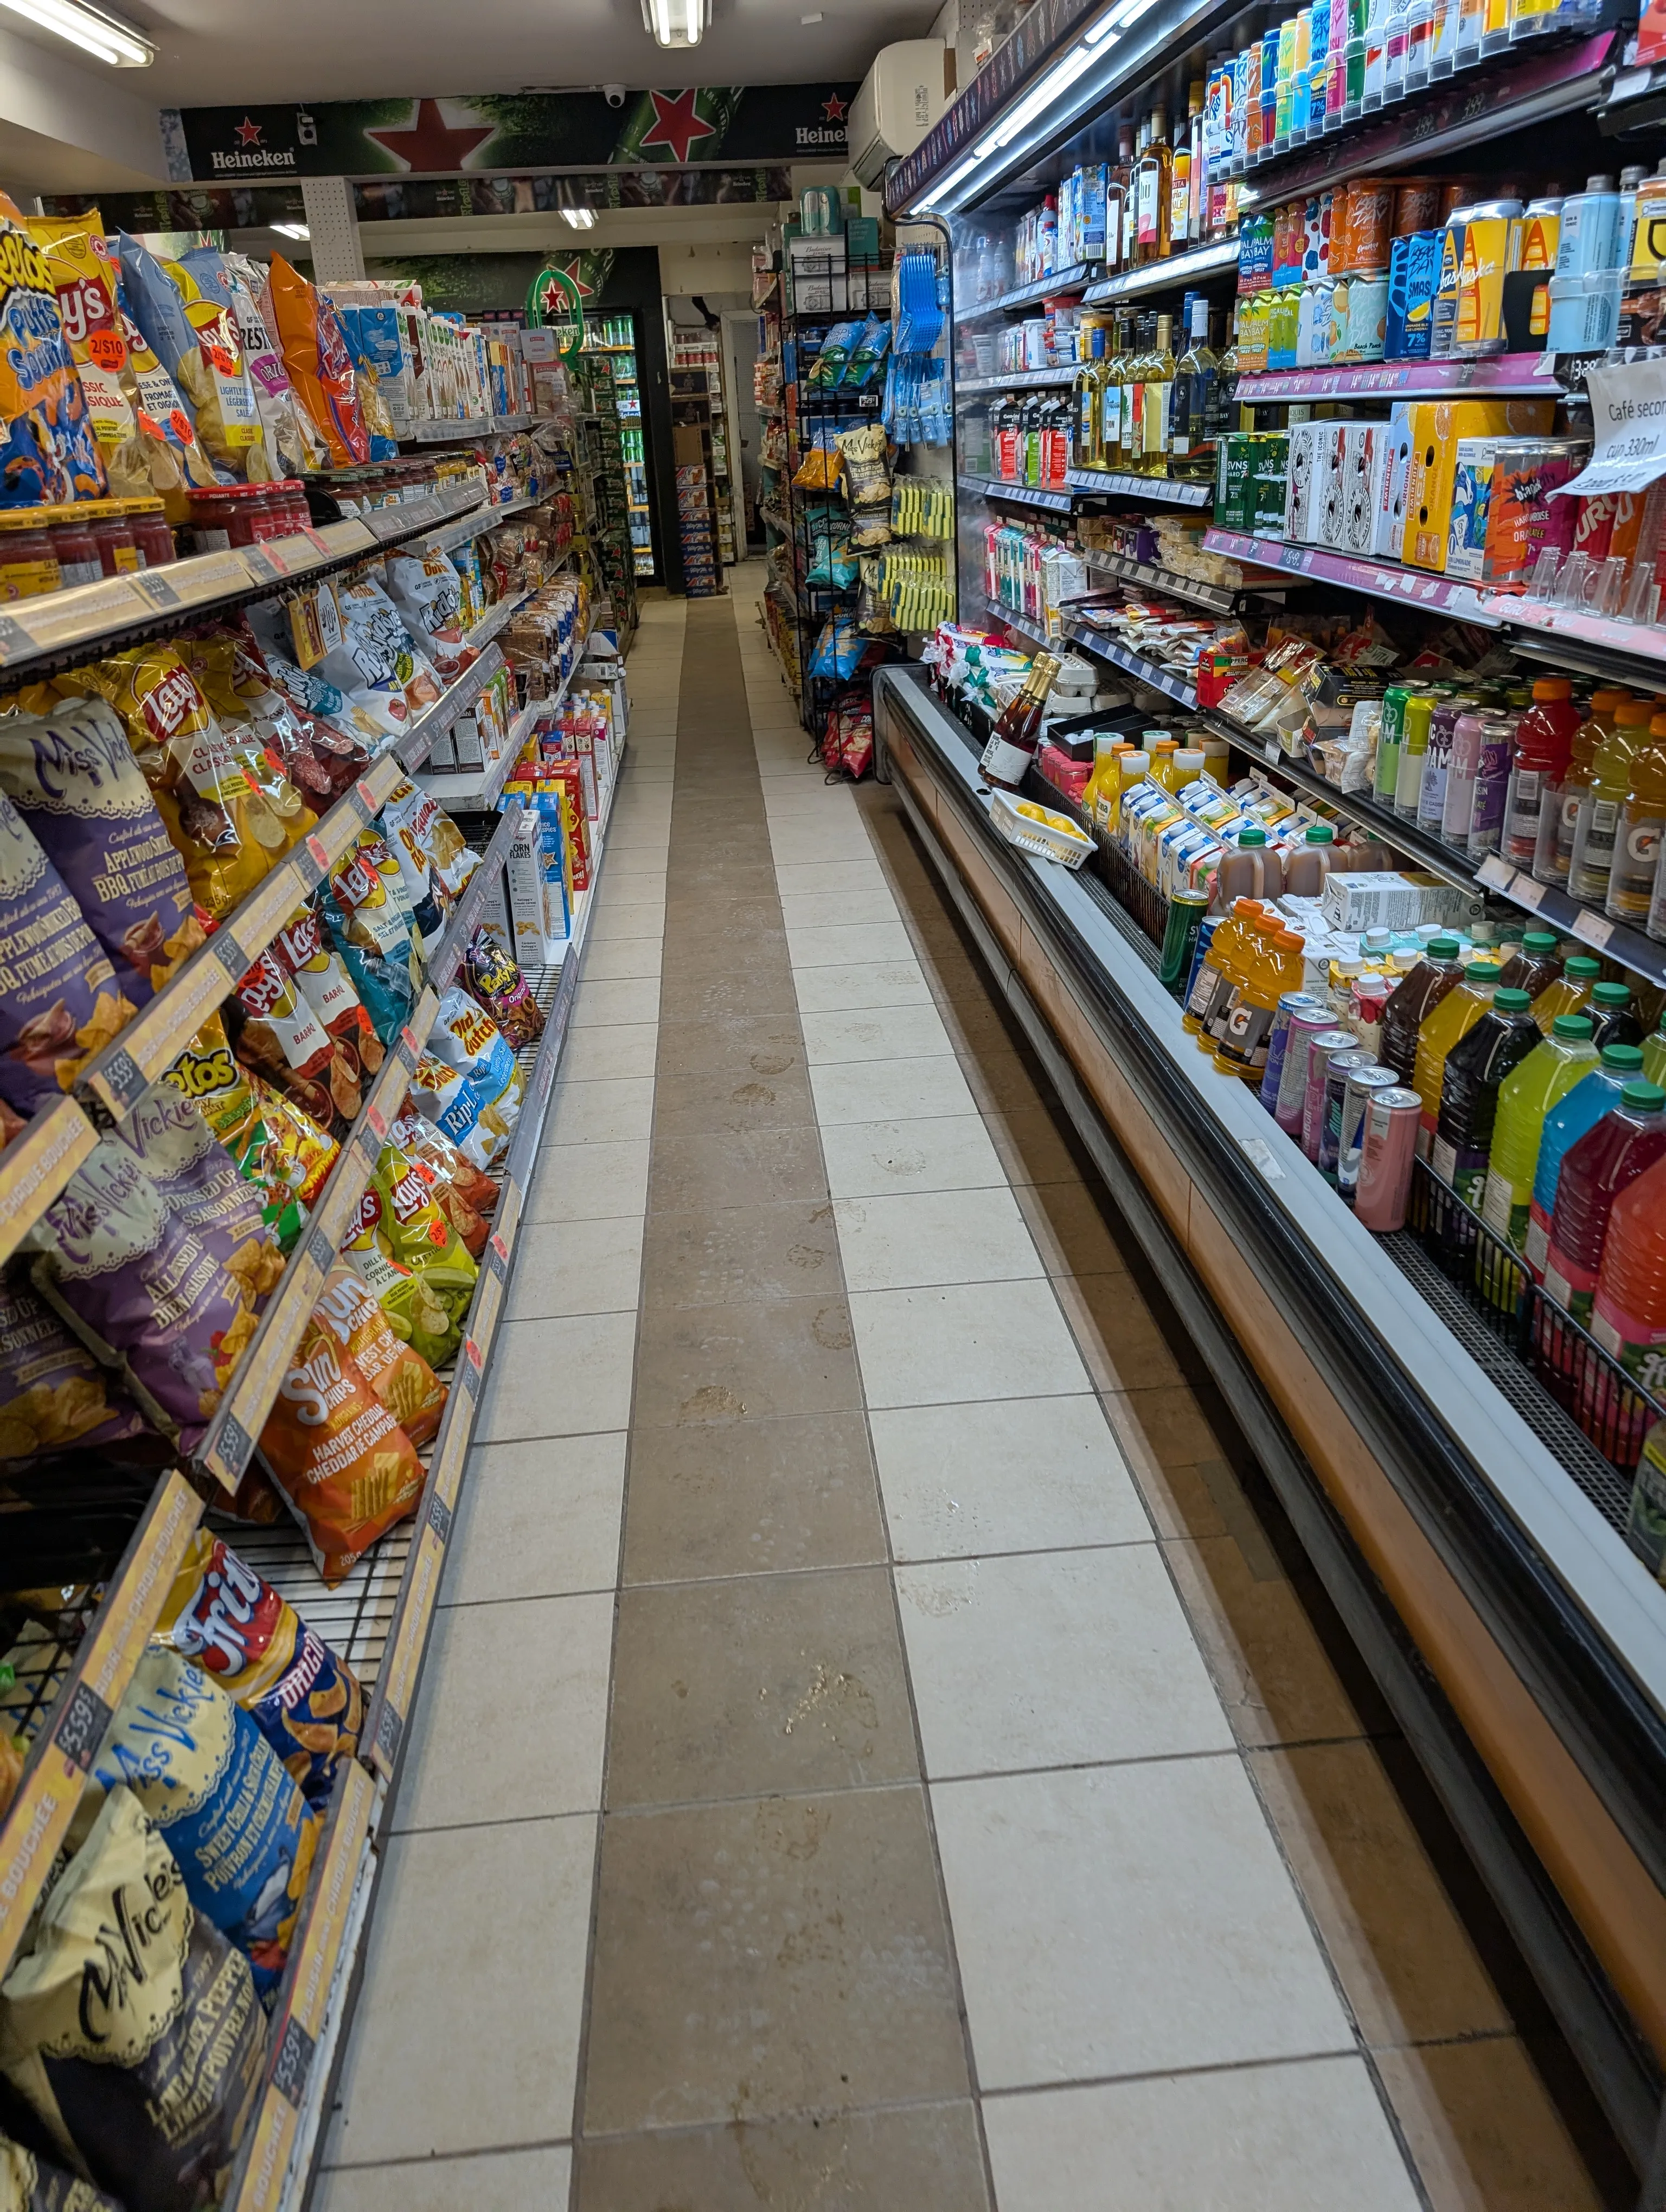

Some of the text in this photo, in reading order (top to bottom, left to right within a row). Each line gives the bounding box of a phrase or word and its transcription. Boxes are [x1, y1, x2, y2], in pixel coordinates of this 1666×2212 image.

[1311, 99, 1325, 118] 7%
[210, 150, 296, 169] Heineken
[1254, 236, 1272, 246] PALM
[1254, 246, 1270, 256] BAY
[61, 278, 113, 343] y's
[1251, 320, 1269, 329] PALM
[1252, 327, 1265, 336] BAY
[1408, 332, 1425, 347] 7%
[1609, 400, 1634, 421] Café
[1607, 443, 1626, 459] cup
[450, 1011, 474, 1039] Old
[464, 1017, 498, 1057] Dutch
[40, 1115, 86, 1172] BOUCHÉE
[391, 1169, 430, 1220] Lay's
[280, 1352, 341, 1426] Sun
[325, 1378, 357, 1410] CHIPS
[306, 1446, 361, 1485] CHEDDAR
[363, 1414, 398, 1446] CAMPAG
[312, 1428, 355, 1463] HARVEST
